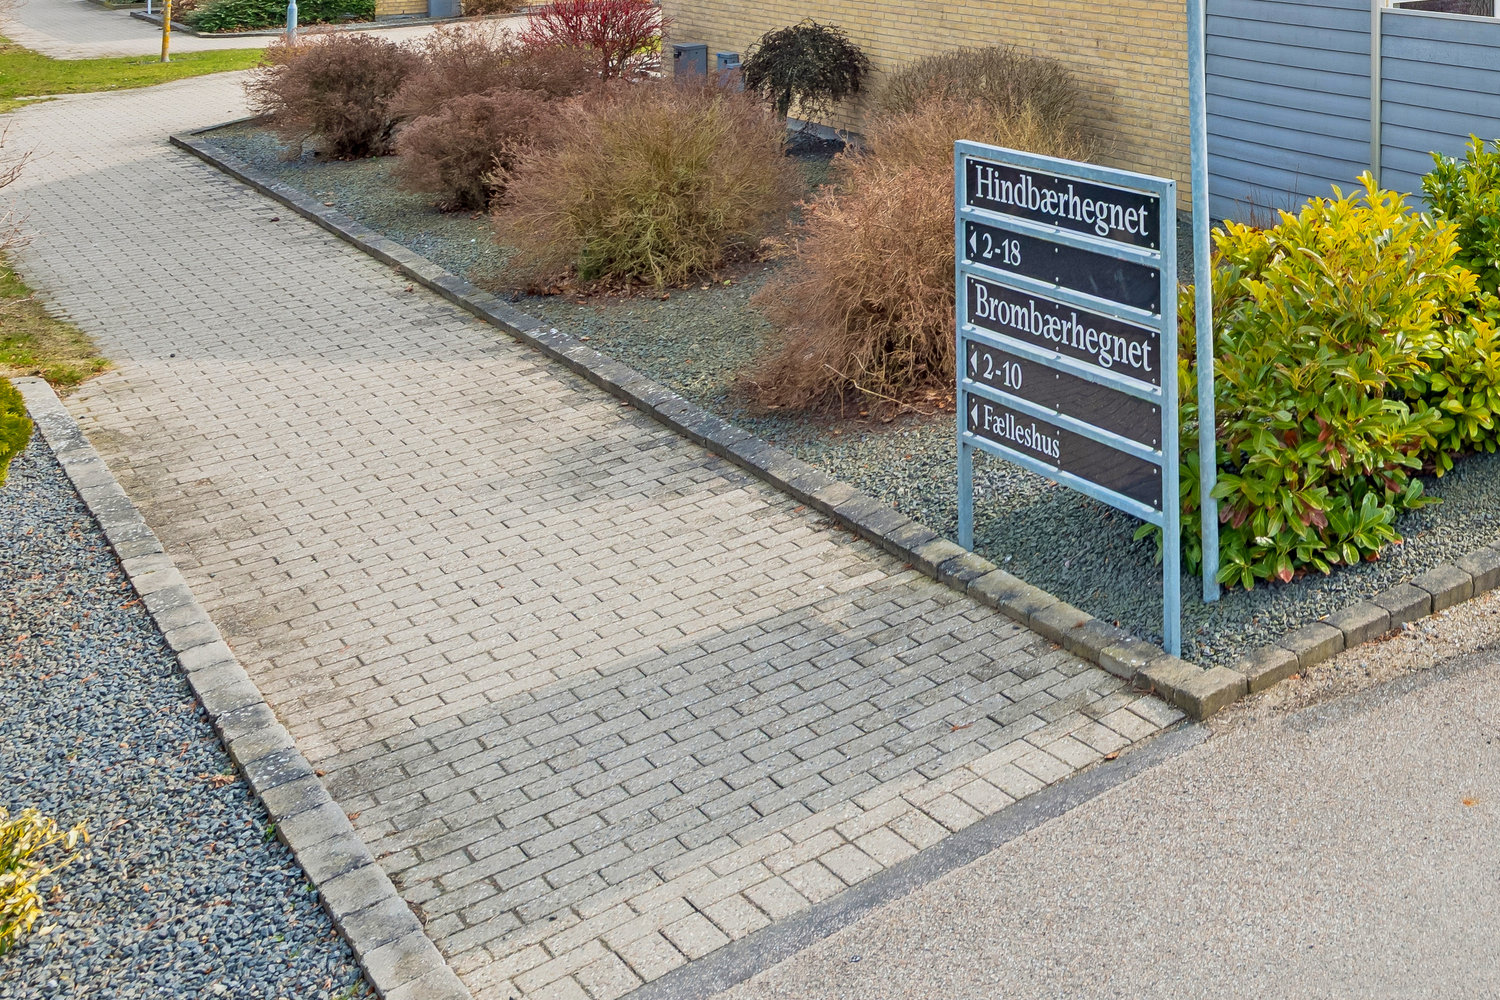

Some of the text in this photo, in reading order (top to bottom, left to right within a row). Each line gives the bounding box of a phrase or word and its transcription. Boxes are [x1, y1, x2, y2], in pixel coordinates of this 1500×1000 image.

[975, 165, 1148, 236] Hindbærhegnet
[982, 233, 1021, 266] 2-18
[975, 283, 1152, 371] Brombærhegnet
[983, 353, 1023, 390] 2-10
[984, 404, 1060, 458] Fælleshus
